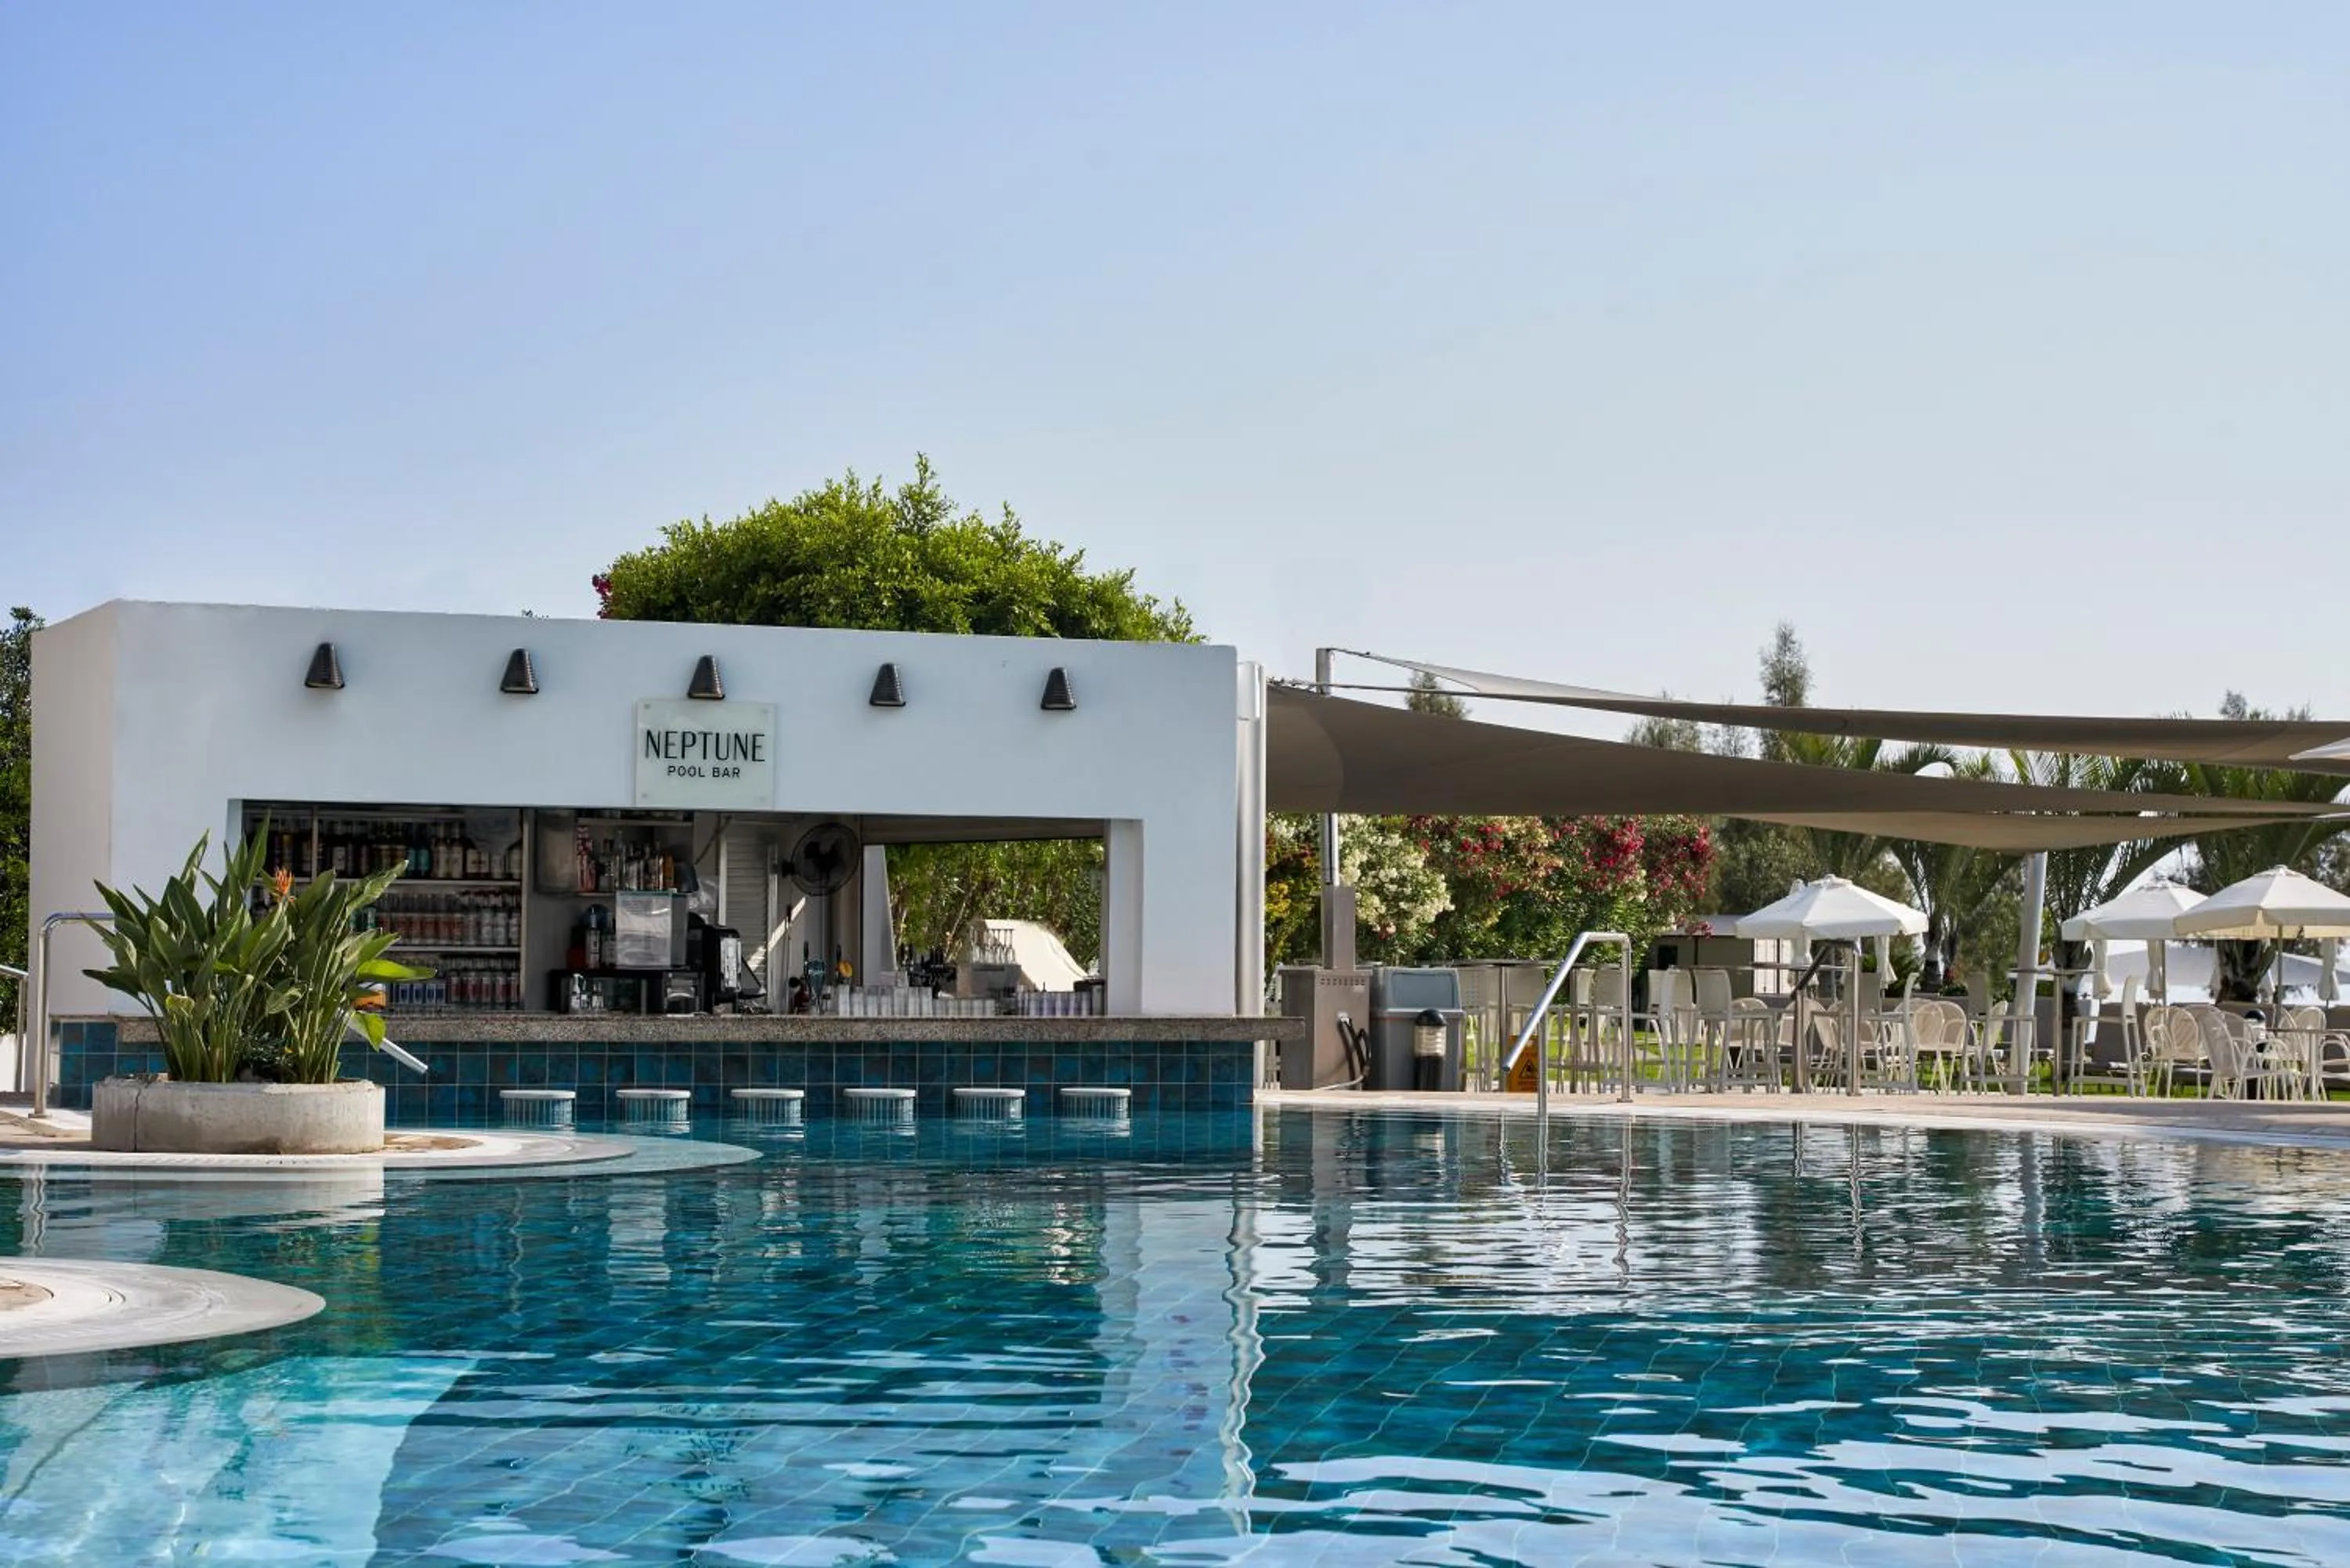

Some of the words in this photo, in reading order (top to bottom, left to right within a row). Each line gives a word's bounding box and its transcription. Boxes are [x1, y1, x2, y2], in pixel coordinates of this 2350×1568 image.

[645, 729, 765, 762] NEPTUNE
[667, 765, 706, 778] POOL
[712, 767, 740, 779] BAR
